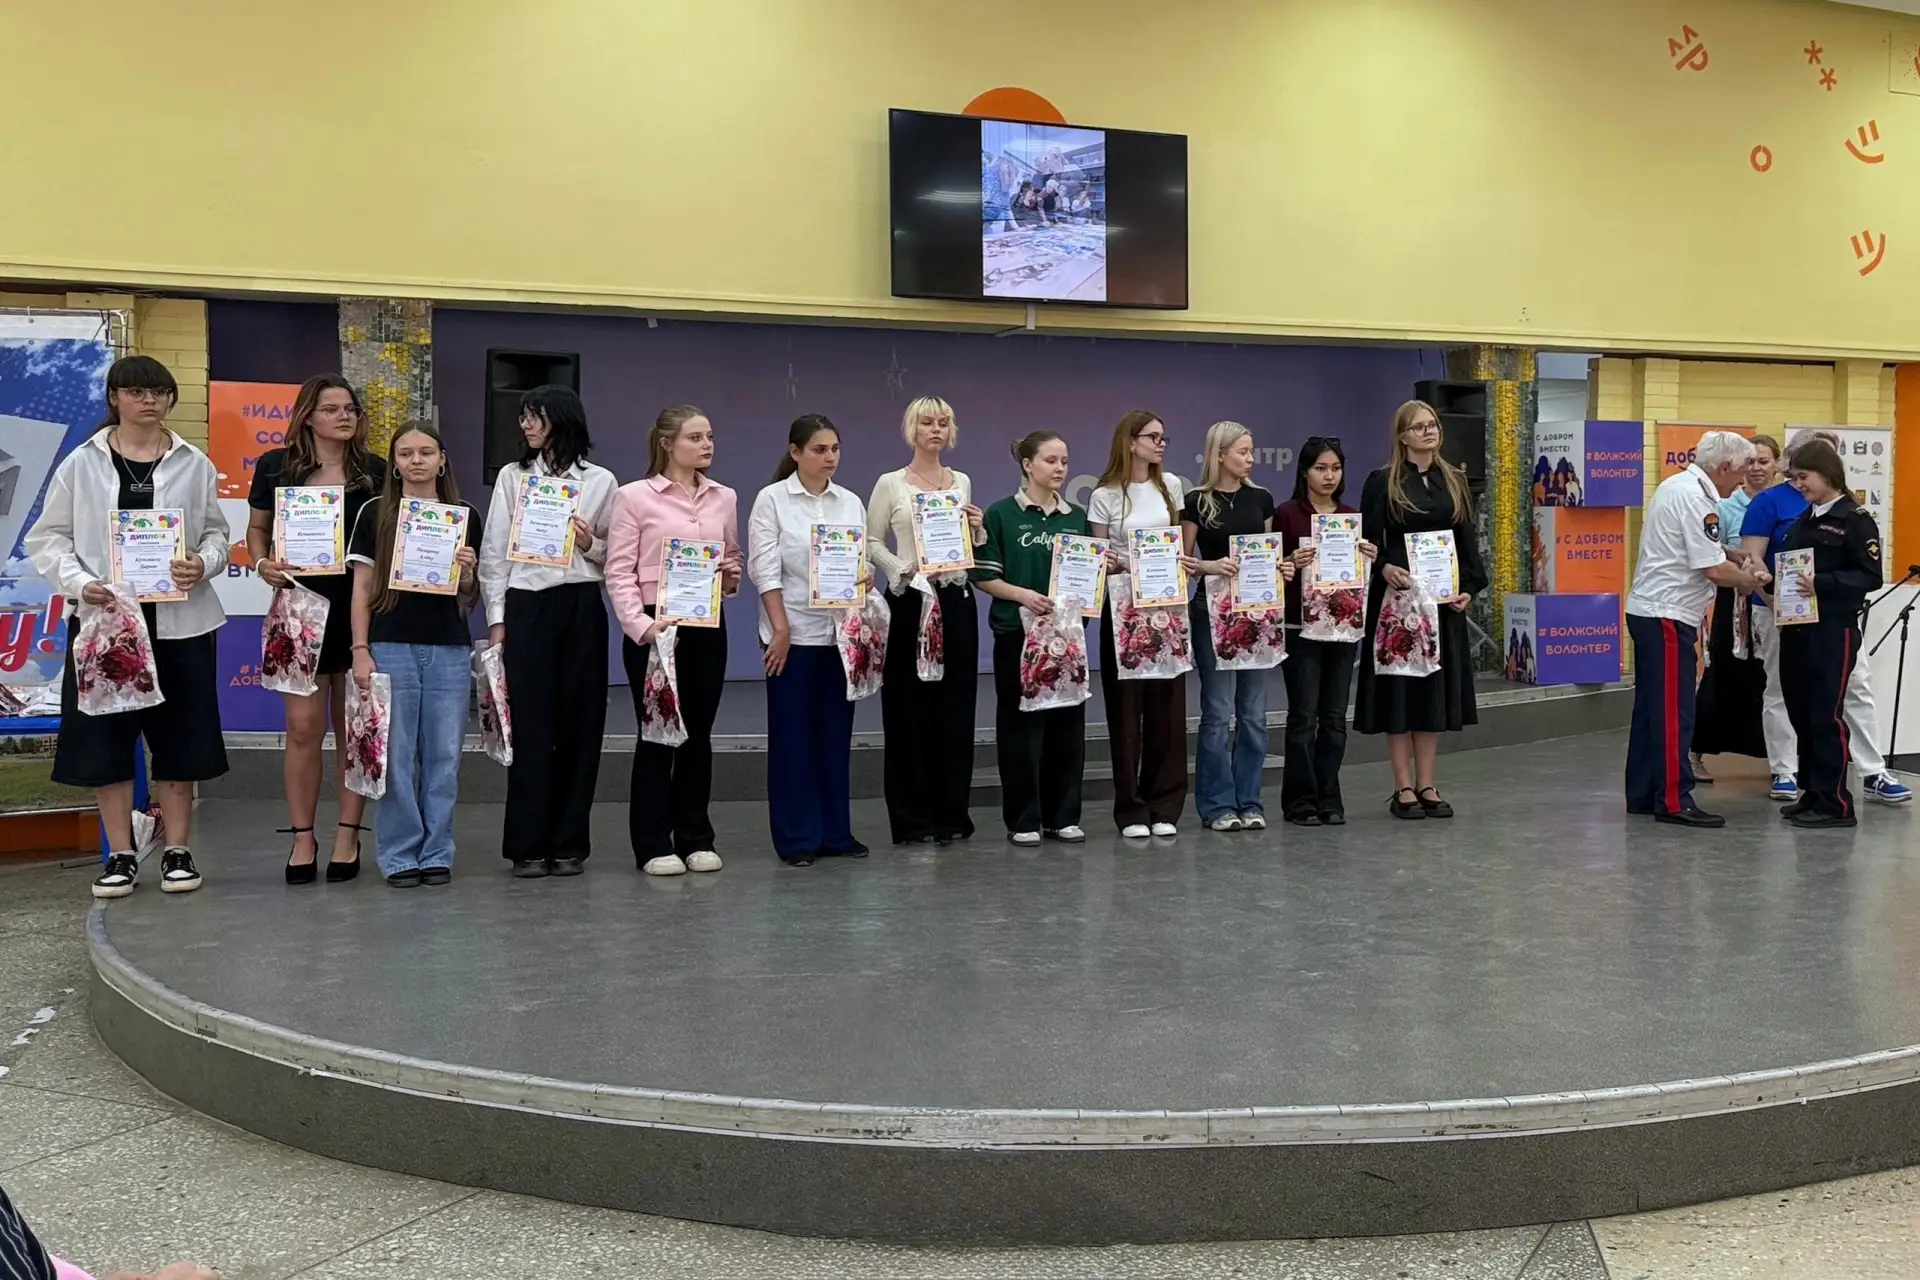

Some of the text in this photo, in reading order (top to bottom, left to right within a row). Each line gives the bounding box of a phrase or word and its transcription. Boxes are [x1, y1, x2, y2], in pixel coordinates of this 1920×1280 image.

[1543, 433, 1574, 441] ДОБРОМ
[1593, 449, 1643, 461] ВОЛЖСКИЙ
[1590, 468, 1638, 478] ВОЛОНТЕР
[1575, 533, 1624, 545] ДОБРОМ
[1567, 549, 1613, 560] ВМЕСТЕ
[1550, 622, 1618, 637] ВОЛЖСКИЙ
[1545, 643, 1612, 655] ВОЛОНТЕР
